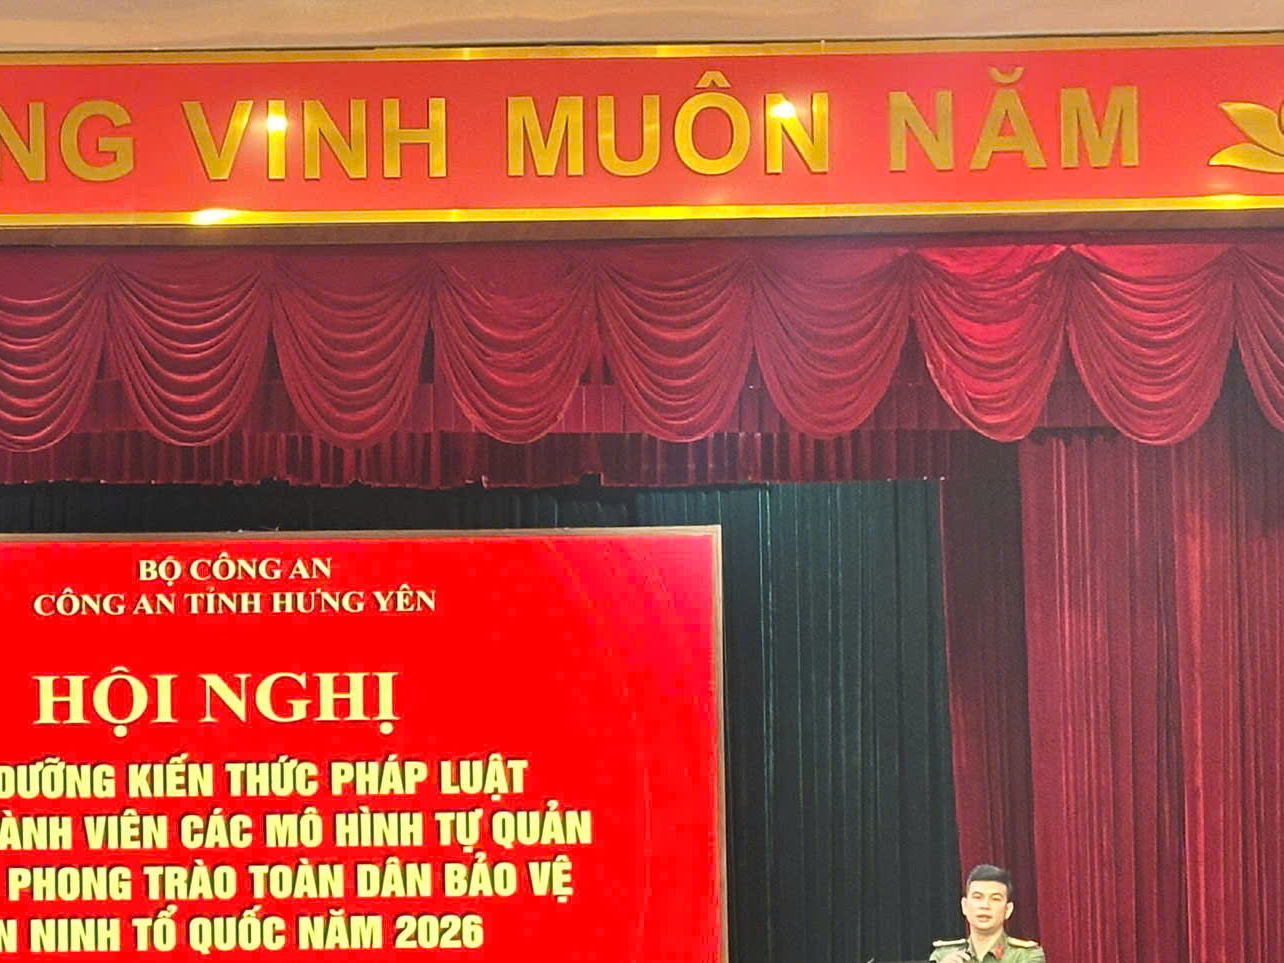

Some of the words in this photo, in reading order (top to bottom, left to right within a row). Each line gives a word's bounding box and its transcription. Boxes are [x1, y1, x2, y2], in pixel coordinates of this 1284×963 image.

[182, 97, 448, 181] VINH
[507, 70, 831, 178] MUÔN
[888, 67, 1142, 172] NĂM
[139, 556, 183, 587] BỘ
[190, 552, 282, 582] CÔNG
[290, 558, 332, 580] AN
[33, 588, 126, 617] CÔNG
[133, 593, 176, 616] AN
[185, 587, 262, 615] TỈNH
[273, 588, 366, 614] HƯNG
[373, 584, 437, 613] YÊN
[33, 665, 180, 738] HỘI
[199, 671, 402, 735] NGHỊ
[128, 753, 215, 799] KIẾN
[226, 755, 320, 798] THỨC
[331, 753, 430, 797] PHÁP
[440, 752, 530, 803] LUẬT
[84, 808, 169, 851] VIÊN
[180, 807, 254, 851] CÁC
[265, 804, 324, 849] MÔ
[336, 804, 424, 848] HÌNH
[435, 811, 483, 857] TỰ
[490, 798, 594, 849] QUẢN
[8, 867, 133, 903] PHONG
[144, 858, 238, 902] TRÀO
[249, 856, 346, 901] TOÀN
[357, 855, 434, 899] DÂN
[445, 852, 518, 898] BẢO
[528, 855, 575, 905] VỆ
[30, 918, 122, 954] NINH
[132, 903, 179, 953] TỔ
[190, 902, 287, 956] QUỐC
[299, 908, 384, 951] NĂM
[395, 914, 485, 950] 2026
